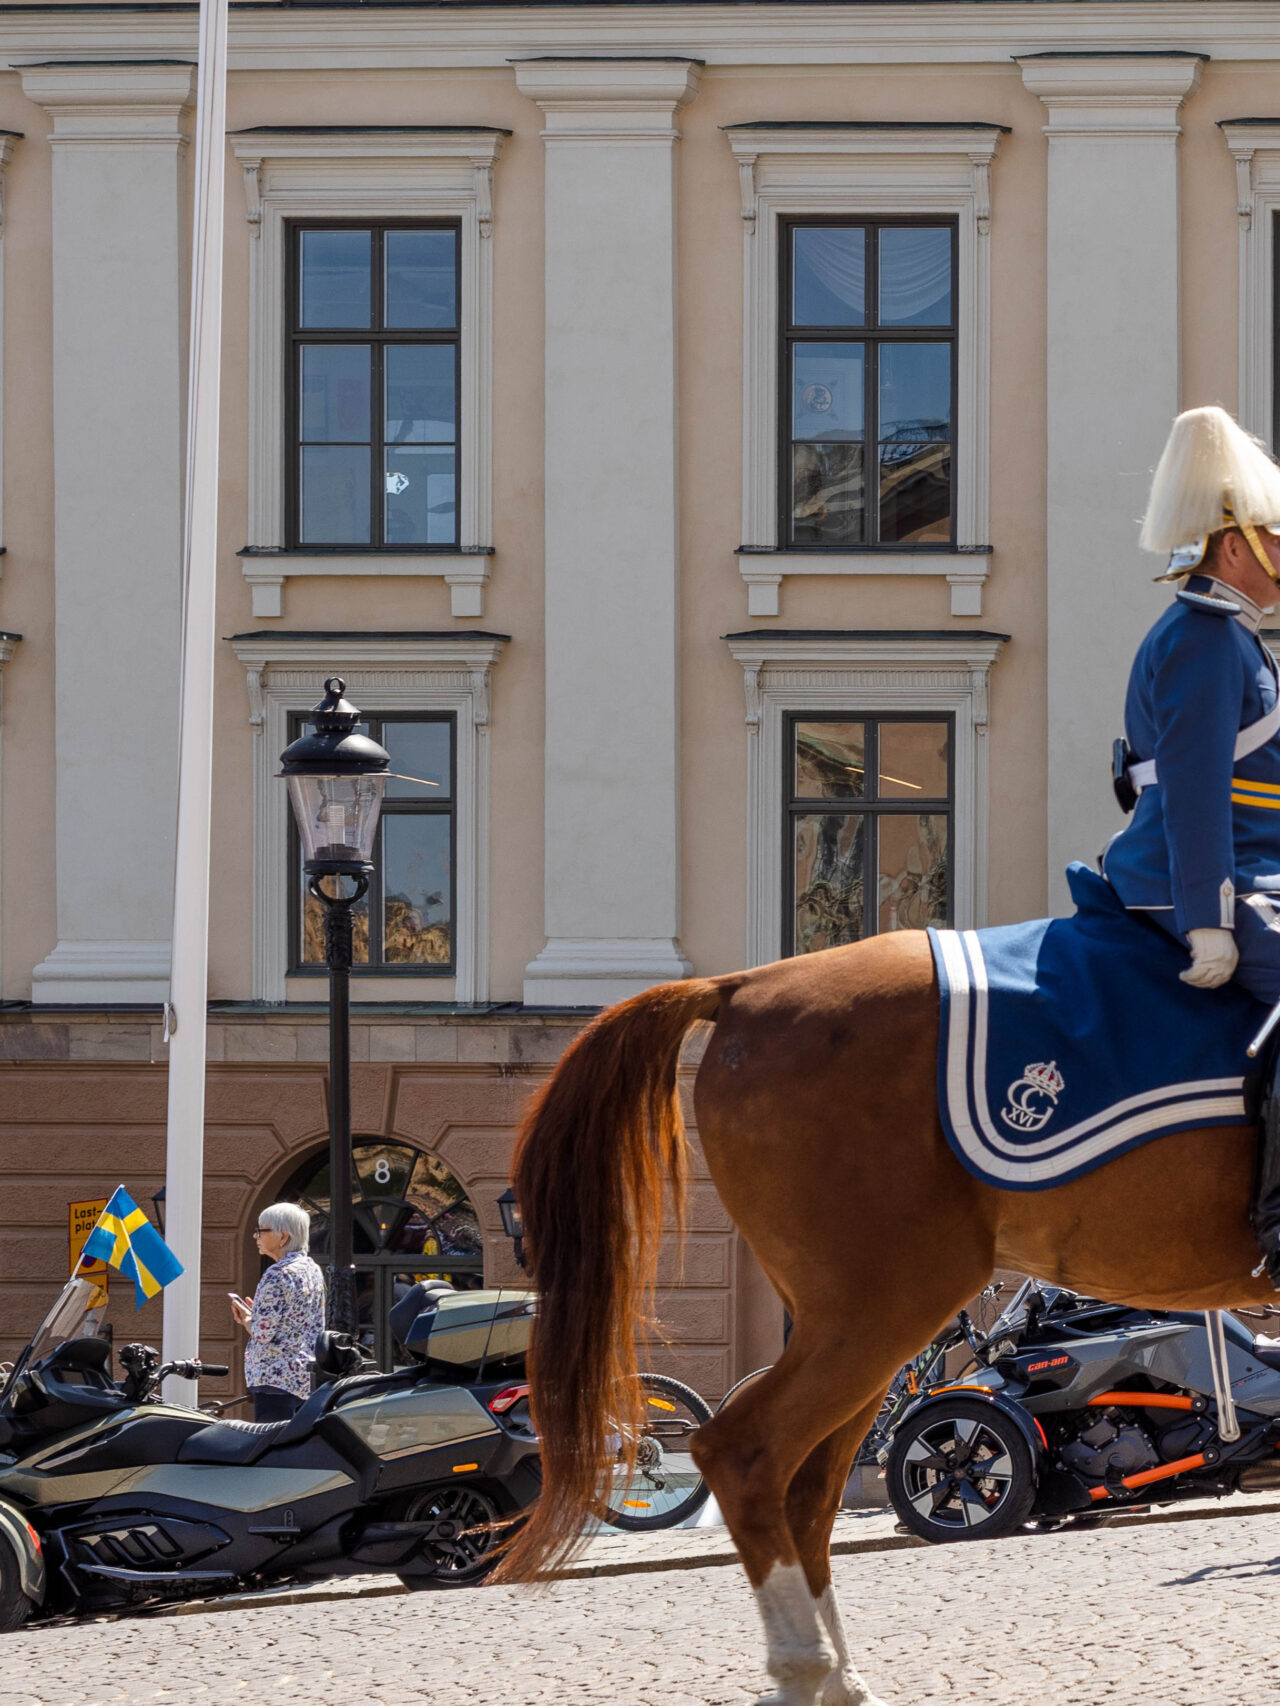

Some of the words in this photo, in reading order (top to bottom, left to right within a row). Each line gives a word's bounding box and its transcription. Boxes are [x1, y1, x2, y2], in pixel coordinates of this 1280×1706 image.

[374, 1158, 391, 1184] 8
[74, 1206, 104, 1220] Last-
[75, 1219, 97, 1235] plat
